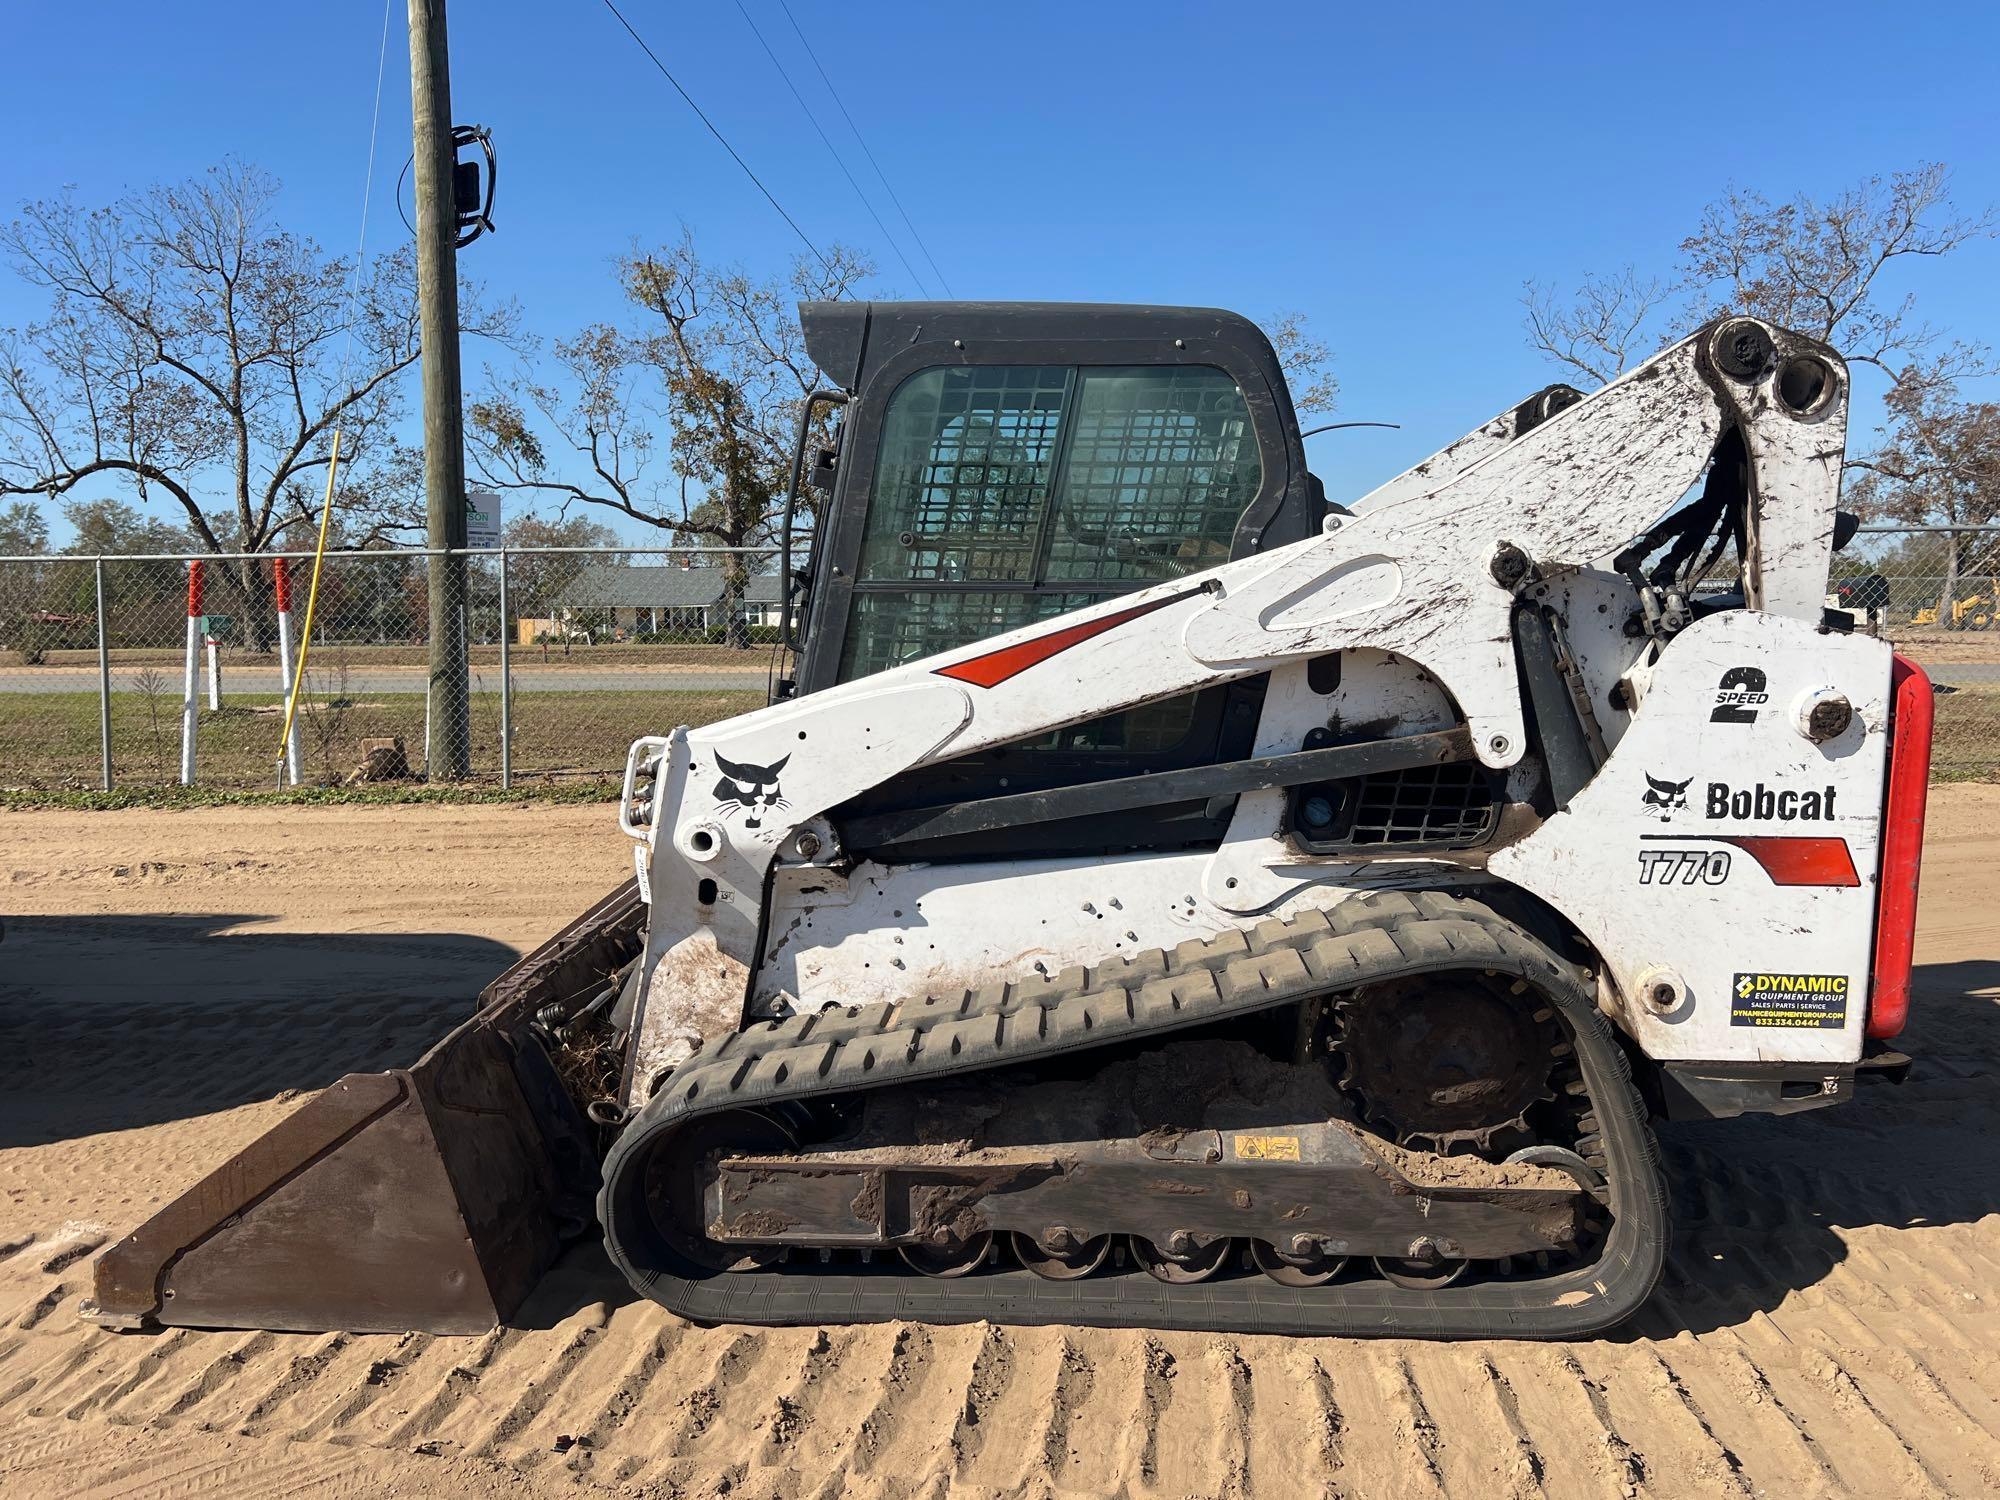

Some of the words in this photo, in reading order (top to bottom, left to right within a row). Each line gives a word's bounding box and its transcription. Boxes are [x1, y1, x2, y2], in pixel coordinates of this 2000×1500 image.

[468, 513, 488, 521] SON
[1709, 666, 1767, 723] 2
[1715, 692, 1769, 704] SPEED
[1706, 782, 1836, 821] Bobcat
[1638, 851, 1732, 885] T770
[1756, 975, 1846, 993] DYNAMIC
[1755, 992, 1809, 1001] EQUIPMENT
[1733, 1010, 1844, 1019] DYNAMICEQUIPMENTGROUP.COM
[1756, 1018, 1820, 1026] 833.334.0444
